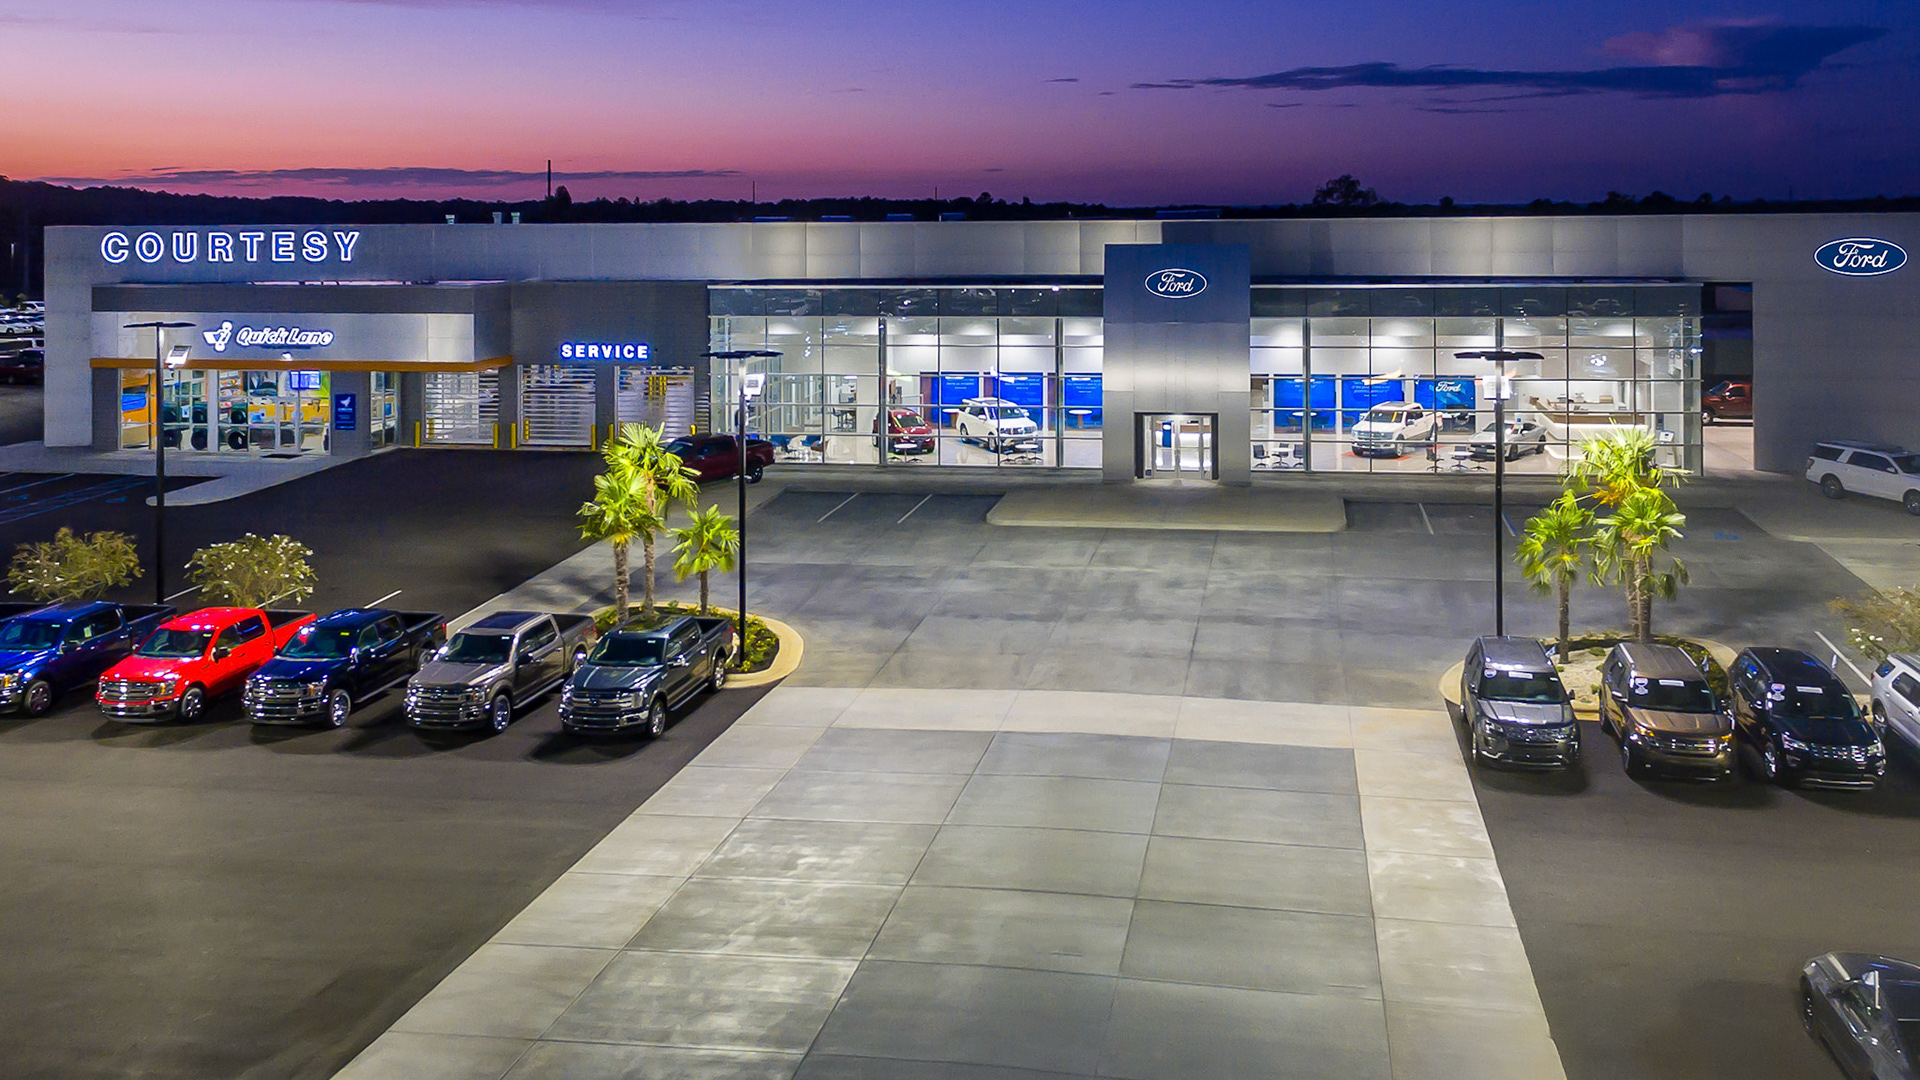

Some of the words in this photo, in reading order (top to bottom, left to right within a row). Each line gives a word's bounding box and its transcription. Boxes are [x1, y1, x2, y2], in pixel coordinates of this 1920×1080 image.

[102, 232, 359, 262] COURTESY
[1833, 242, 1888, 267] Ford
[1157, 271, 1195, 293] Ford
[236, 327, 288, 346] Quick
[287, 328, 333, 345] Lane
[561, 344, 648, 358] SERVICE
[1435, 381, 1462, 393] Ford
